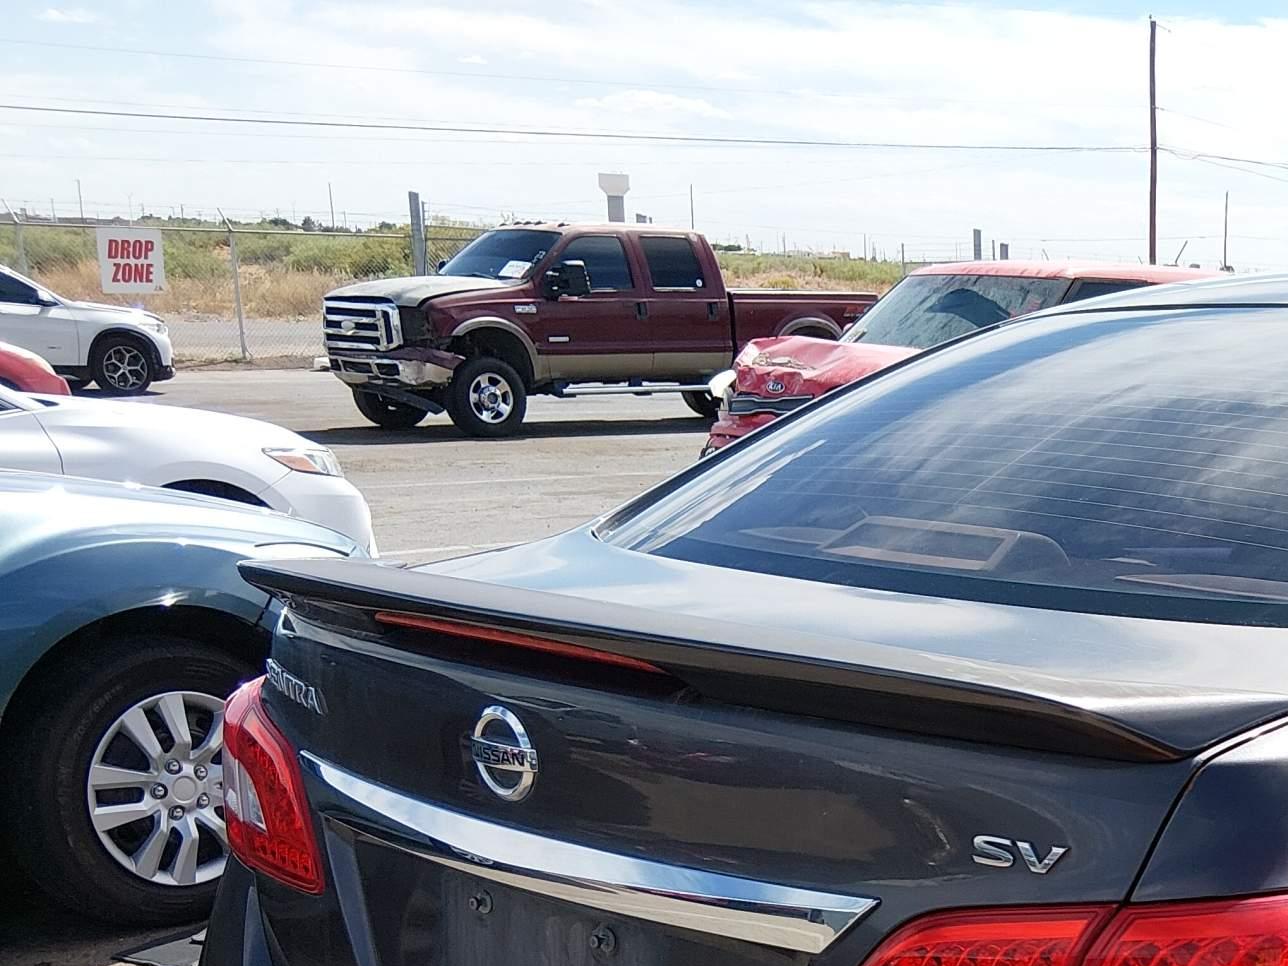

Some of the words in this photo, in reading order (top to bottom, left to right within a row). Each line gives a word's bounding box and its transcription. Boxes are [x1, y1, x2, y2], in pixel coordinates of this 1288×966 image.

[107, 239, 154, 260] DROP
[111, 262, 154, 283] ZONE
[472, 742, 526, 768] NISSAN
[971, 835, 1070, 874] SV
